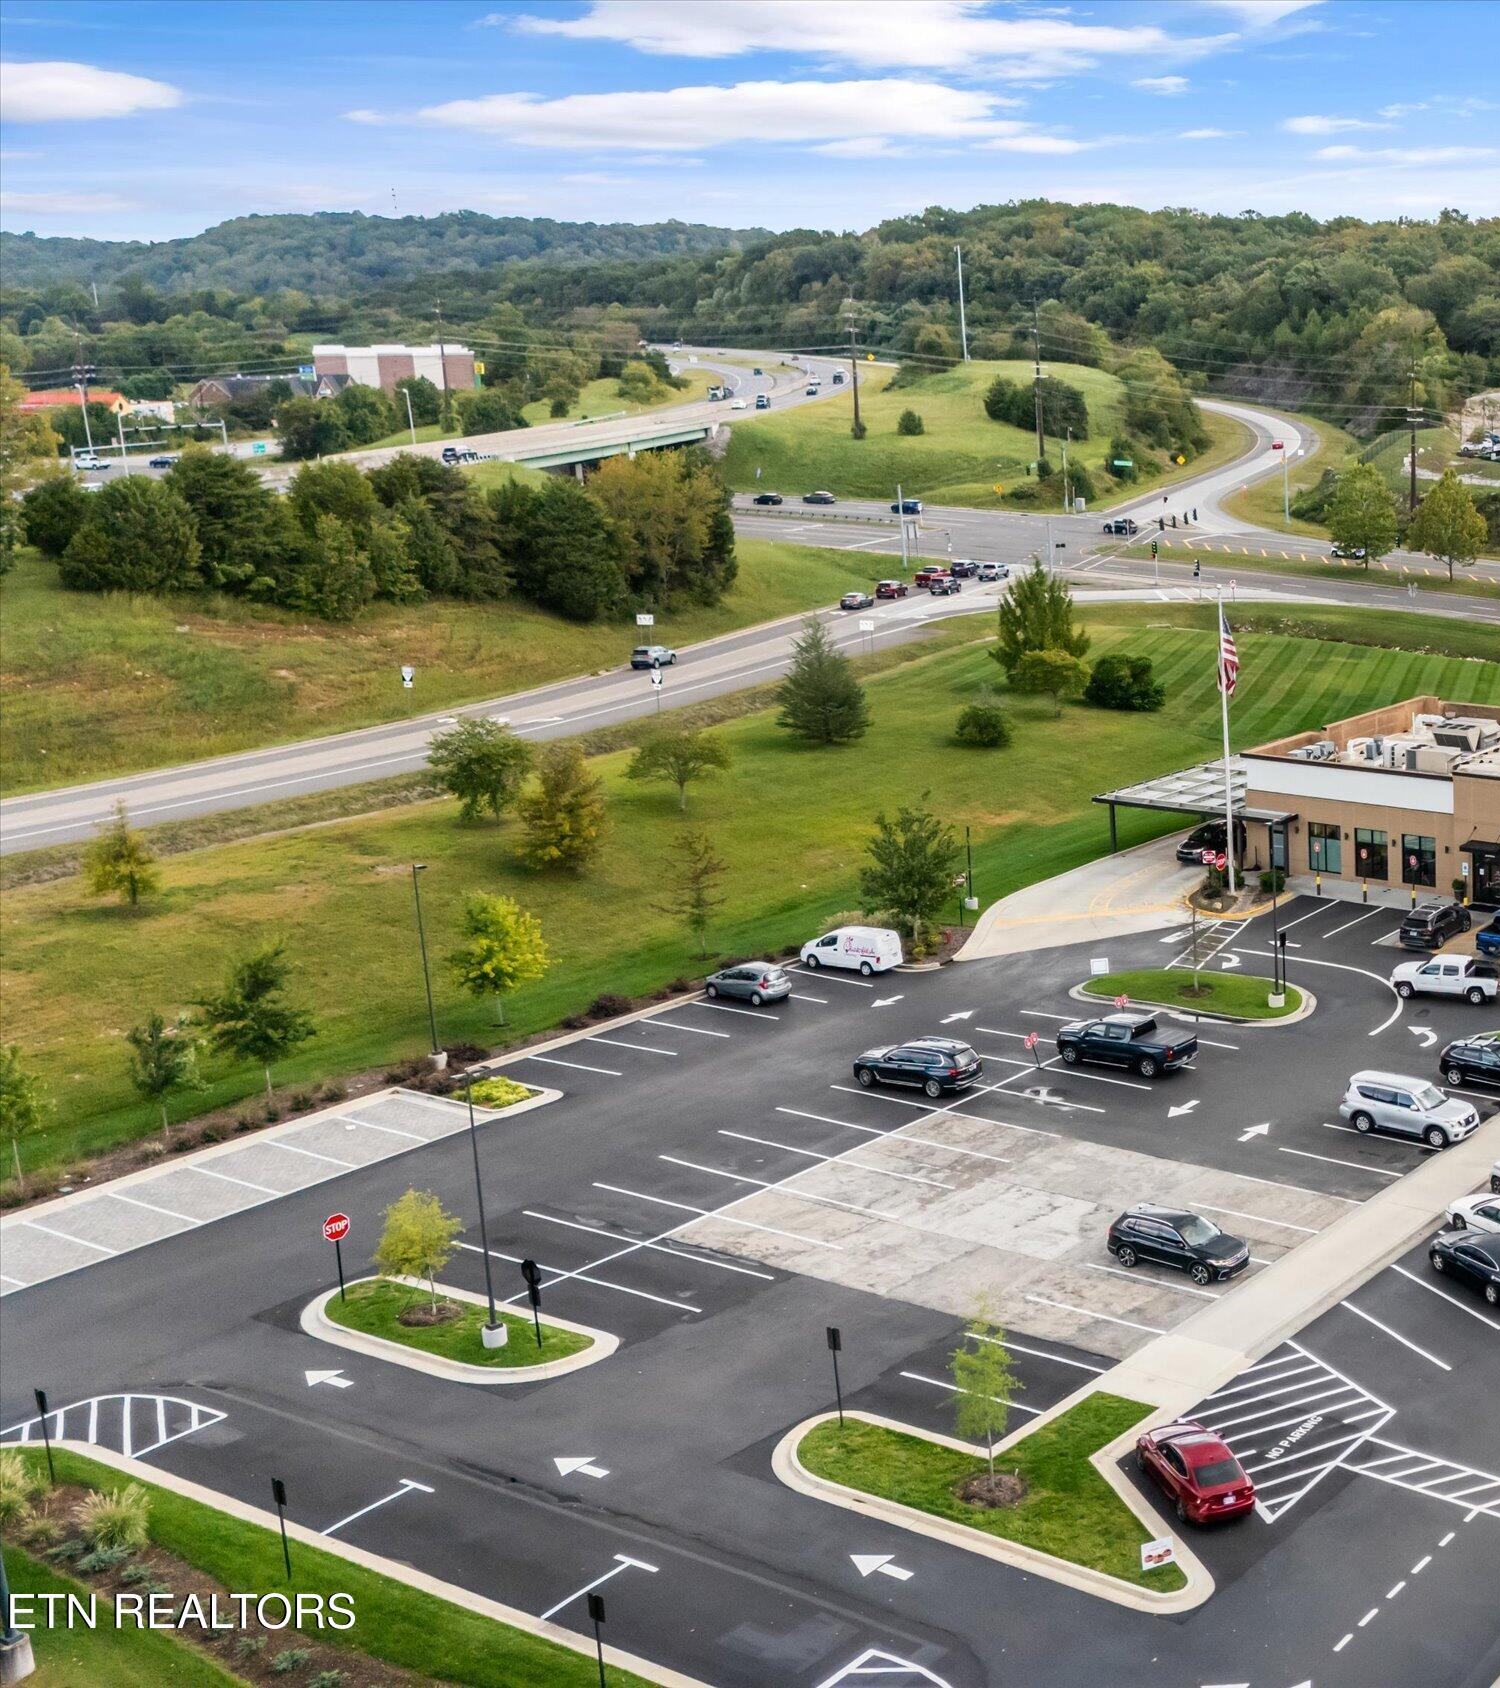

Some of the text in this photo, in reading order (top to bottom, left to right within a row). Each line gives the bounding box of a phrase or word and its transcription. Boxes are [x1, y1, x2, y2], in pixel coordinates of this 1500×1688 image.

[325, 1219, 348, 1235] STOP
[1264, 1414, 1323, 1460] NO PARKING
